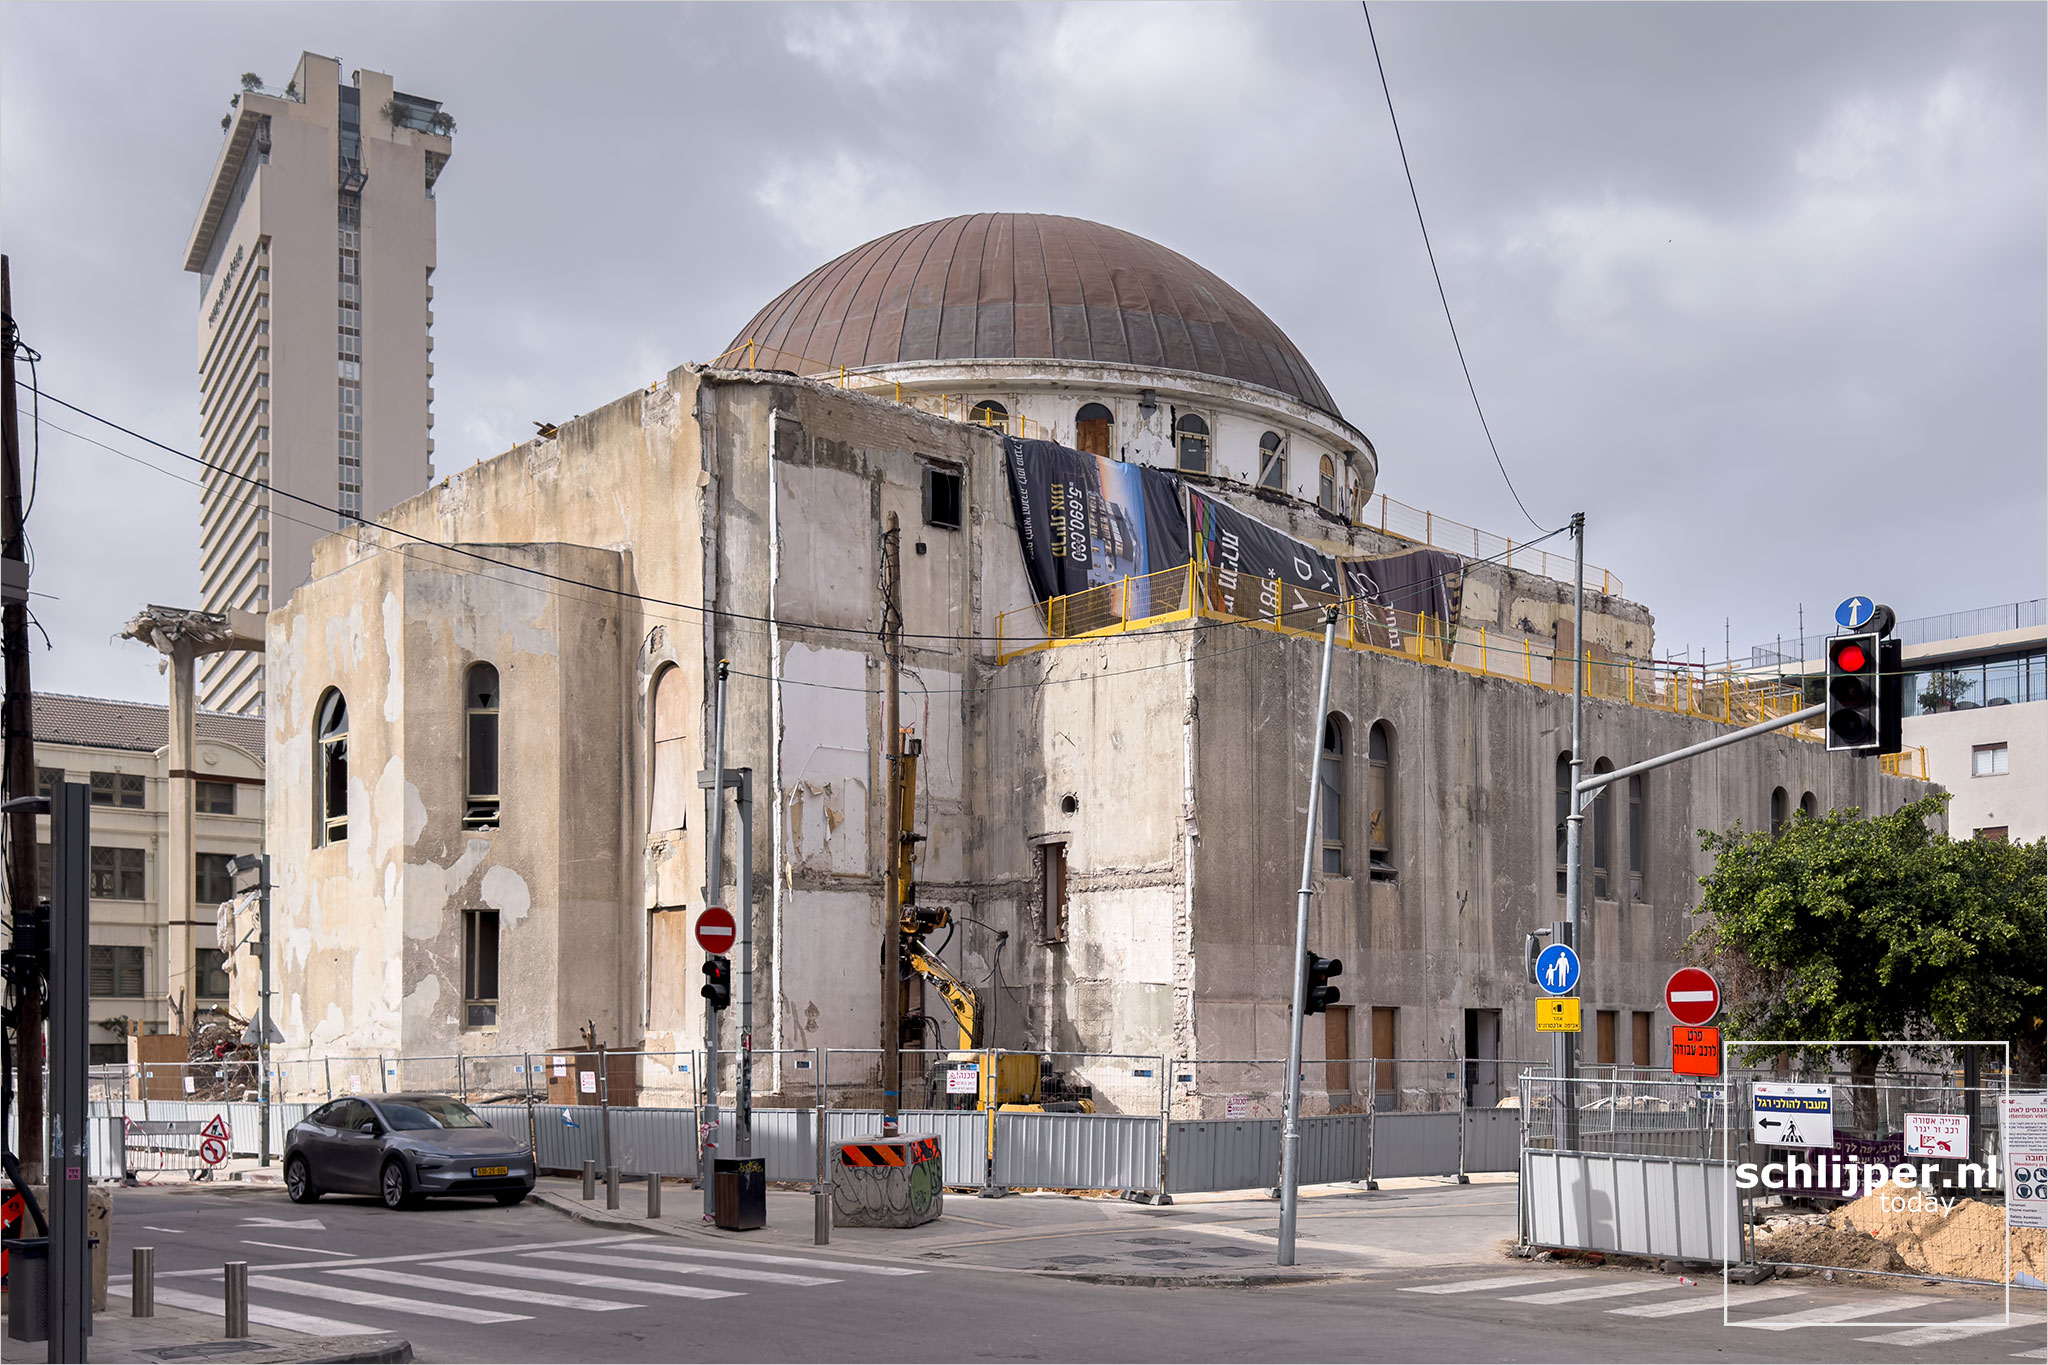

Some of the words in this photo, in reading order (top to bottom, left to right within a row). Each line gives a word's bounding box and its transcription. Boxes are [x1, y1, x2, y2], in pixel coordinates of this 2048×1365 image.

[1688, 1030, 1703, 1041] פרט
[1674, 1044, 1697, 1056] עבודה
[1699, 1044, 1717, 1057] לרכב
[1756, 1097, 1772, 1108] רגל
[1773, 1098, 1801, 1109] להולכי
[1803, 1100, 1828, 1110] מעבר
[1912, 1117, 1936, 1125] אסורה
[1940, 1118, 1960, 1126] חנייה
[1914, 1125, 1930, 1133] יגרר
